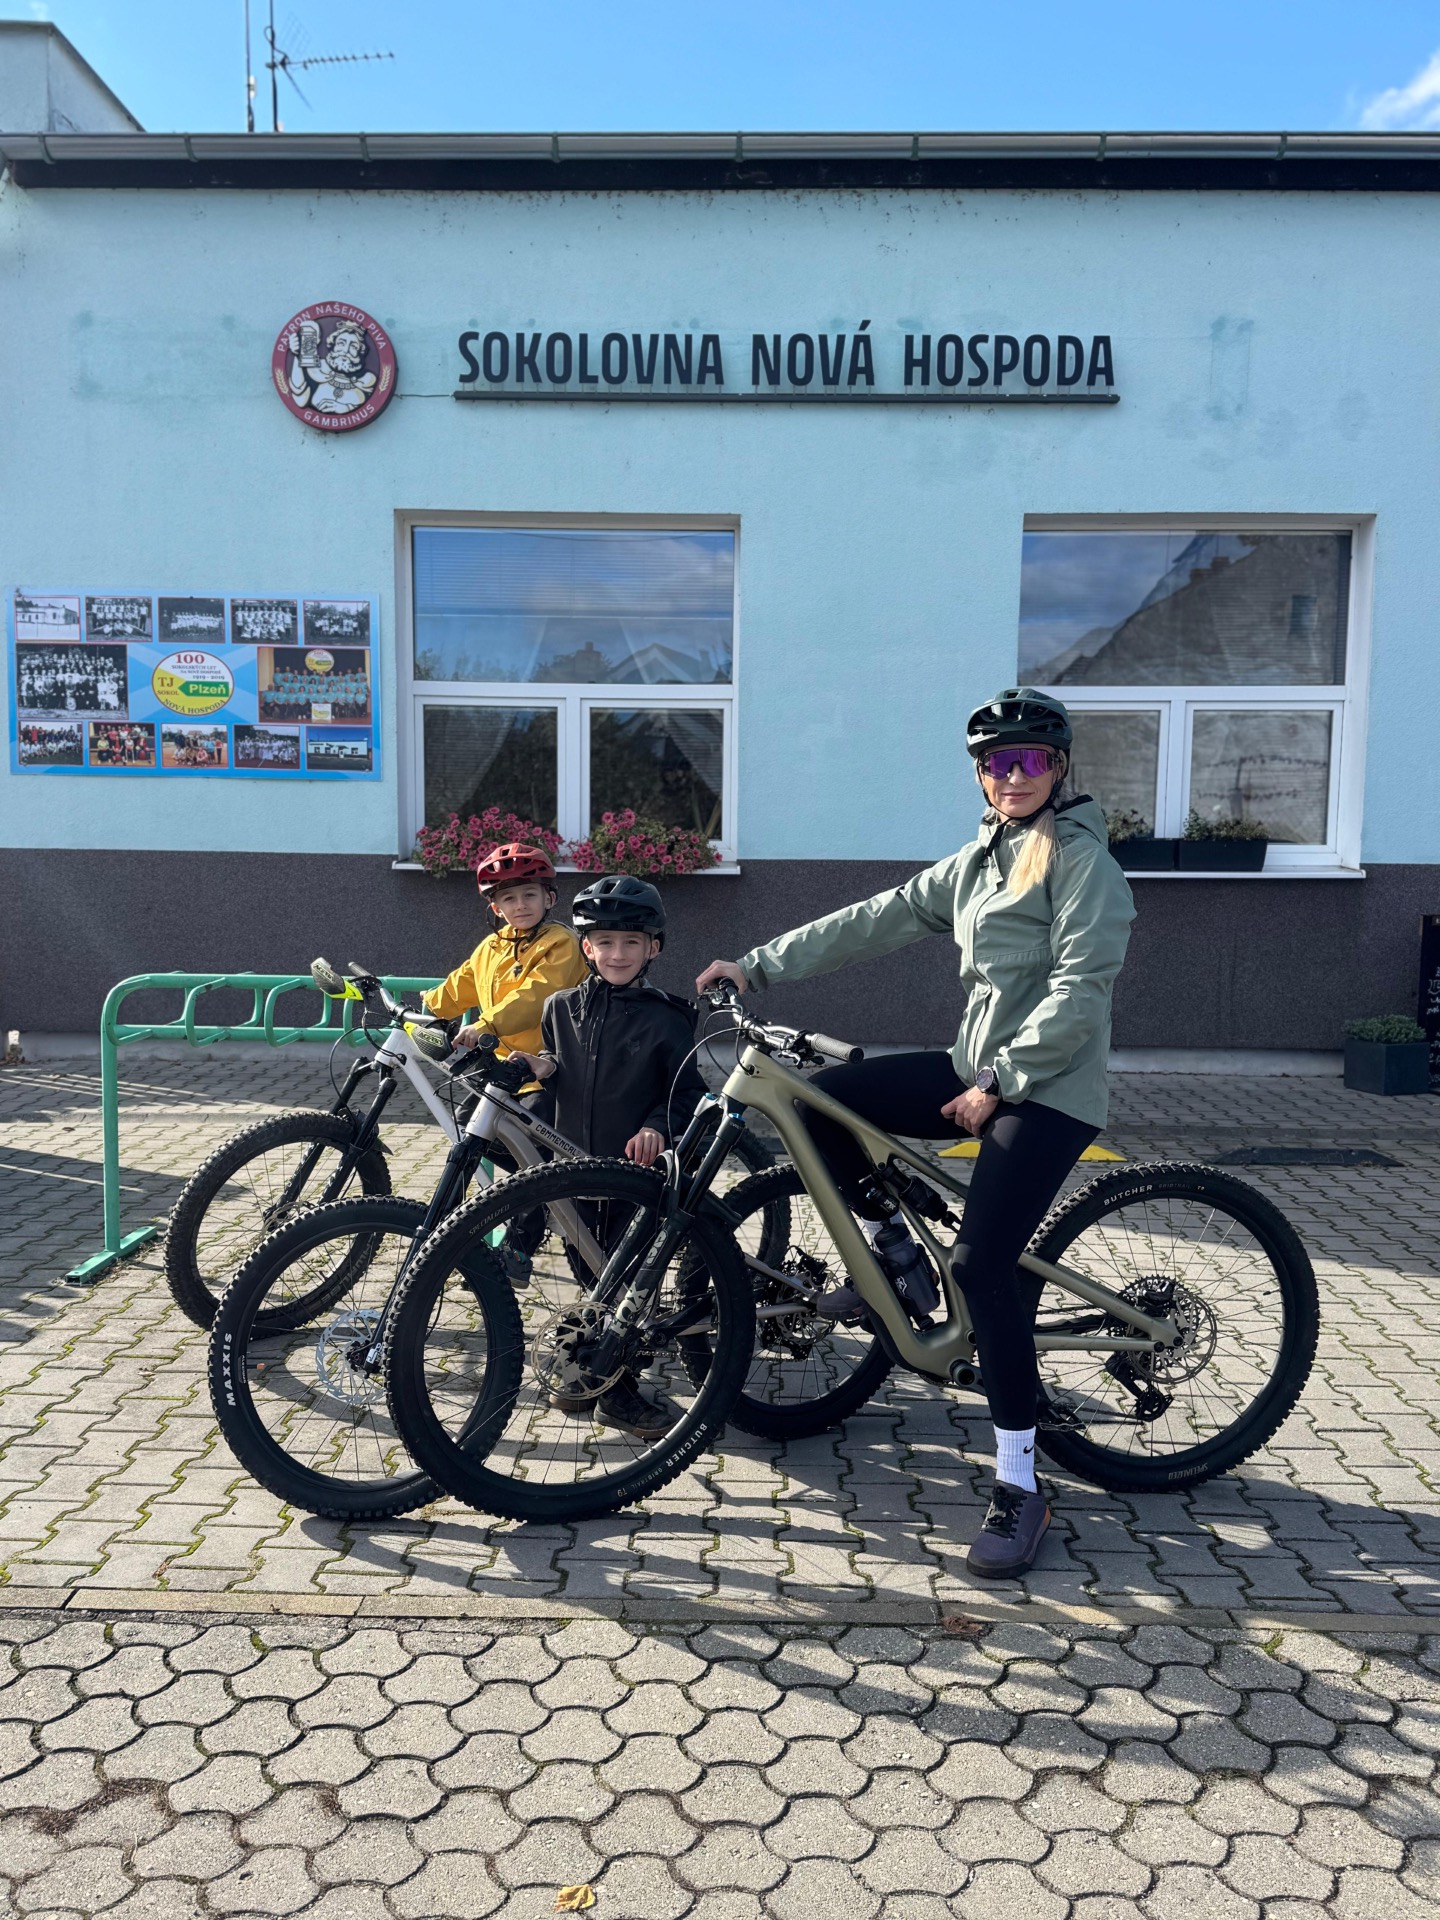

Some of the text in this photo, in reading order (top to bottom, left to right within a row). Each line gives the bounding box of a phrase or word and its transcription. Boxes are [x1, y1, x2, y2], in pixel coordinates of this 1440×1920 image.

[278, 303, 387, 352] PATRON NAŠEHO PIVA
[458, 319, 1115, 387] SOKOLOVNA NOVÁ HOSPODA
[304, 403, 375, 427] GAMBRINUS
[176, 654, 205, 664] 100
[158, 676, 226, 694] TJ Plzeň
[163, 698, 226, 714] NOVÁ HOSPODA
[1104, 1184, 1153, 1206] BUTCHER
[608, 1281, 650, 1338] FOX
[222, 1333, 236, 1407] MAXXIS
[665, 1423, 708, 1468] BUTCHER
[617, 1487, 628, 1498] T9
